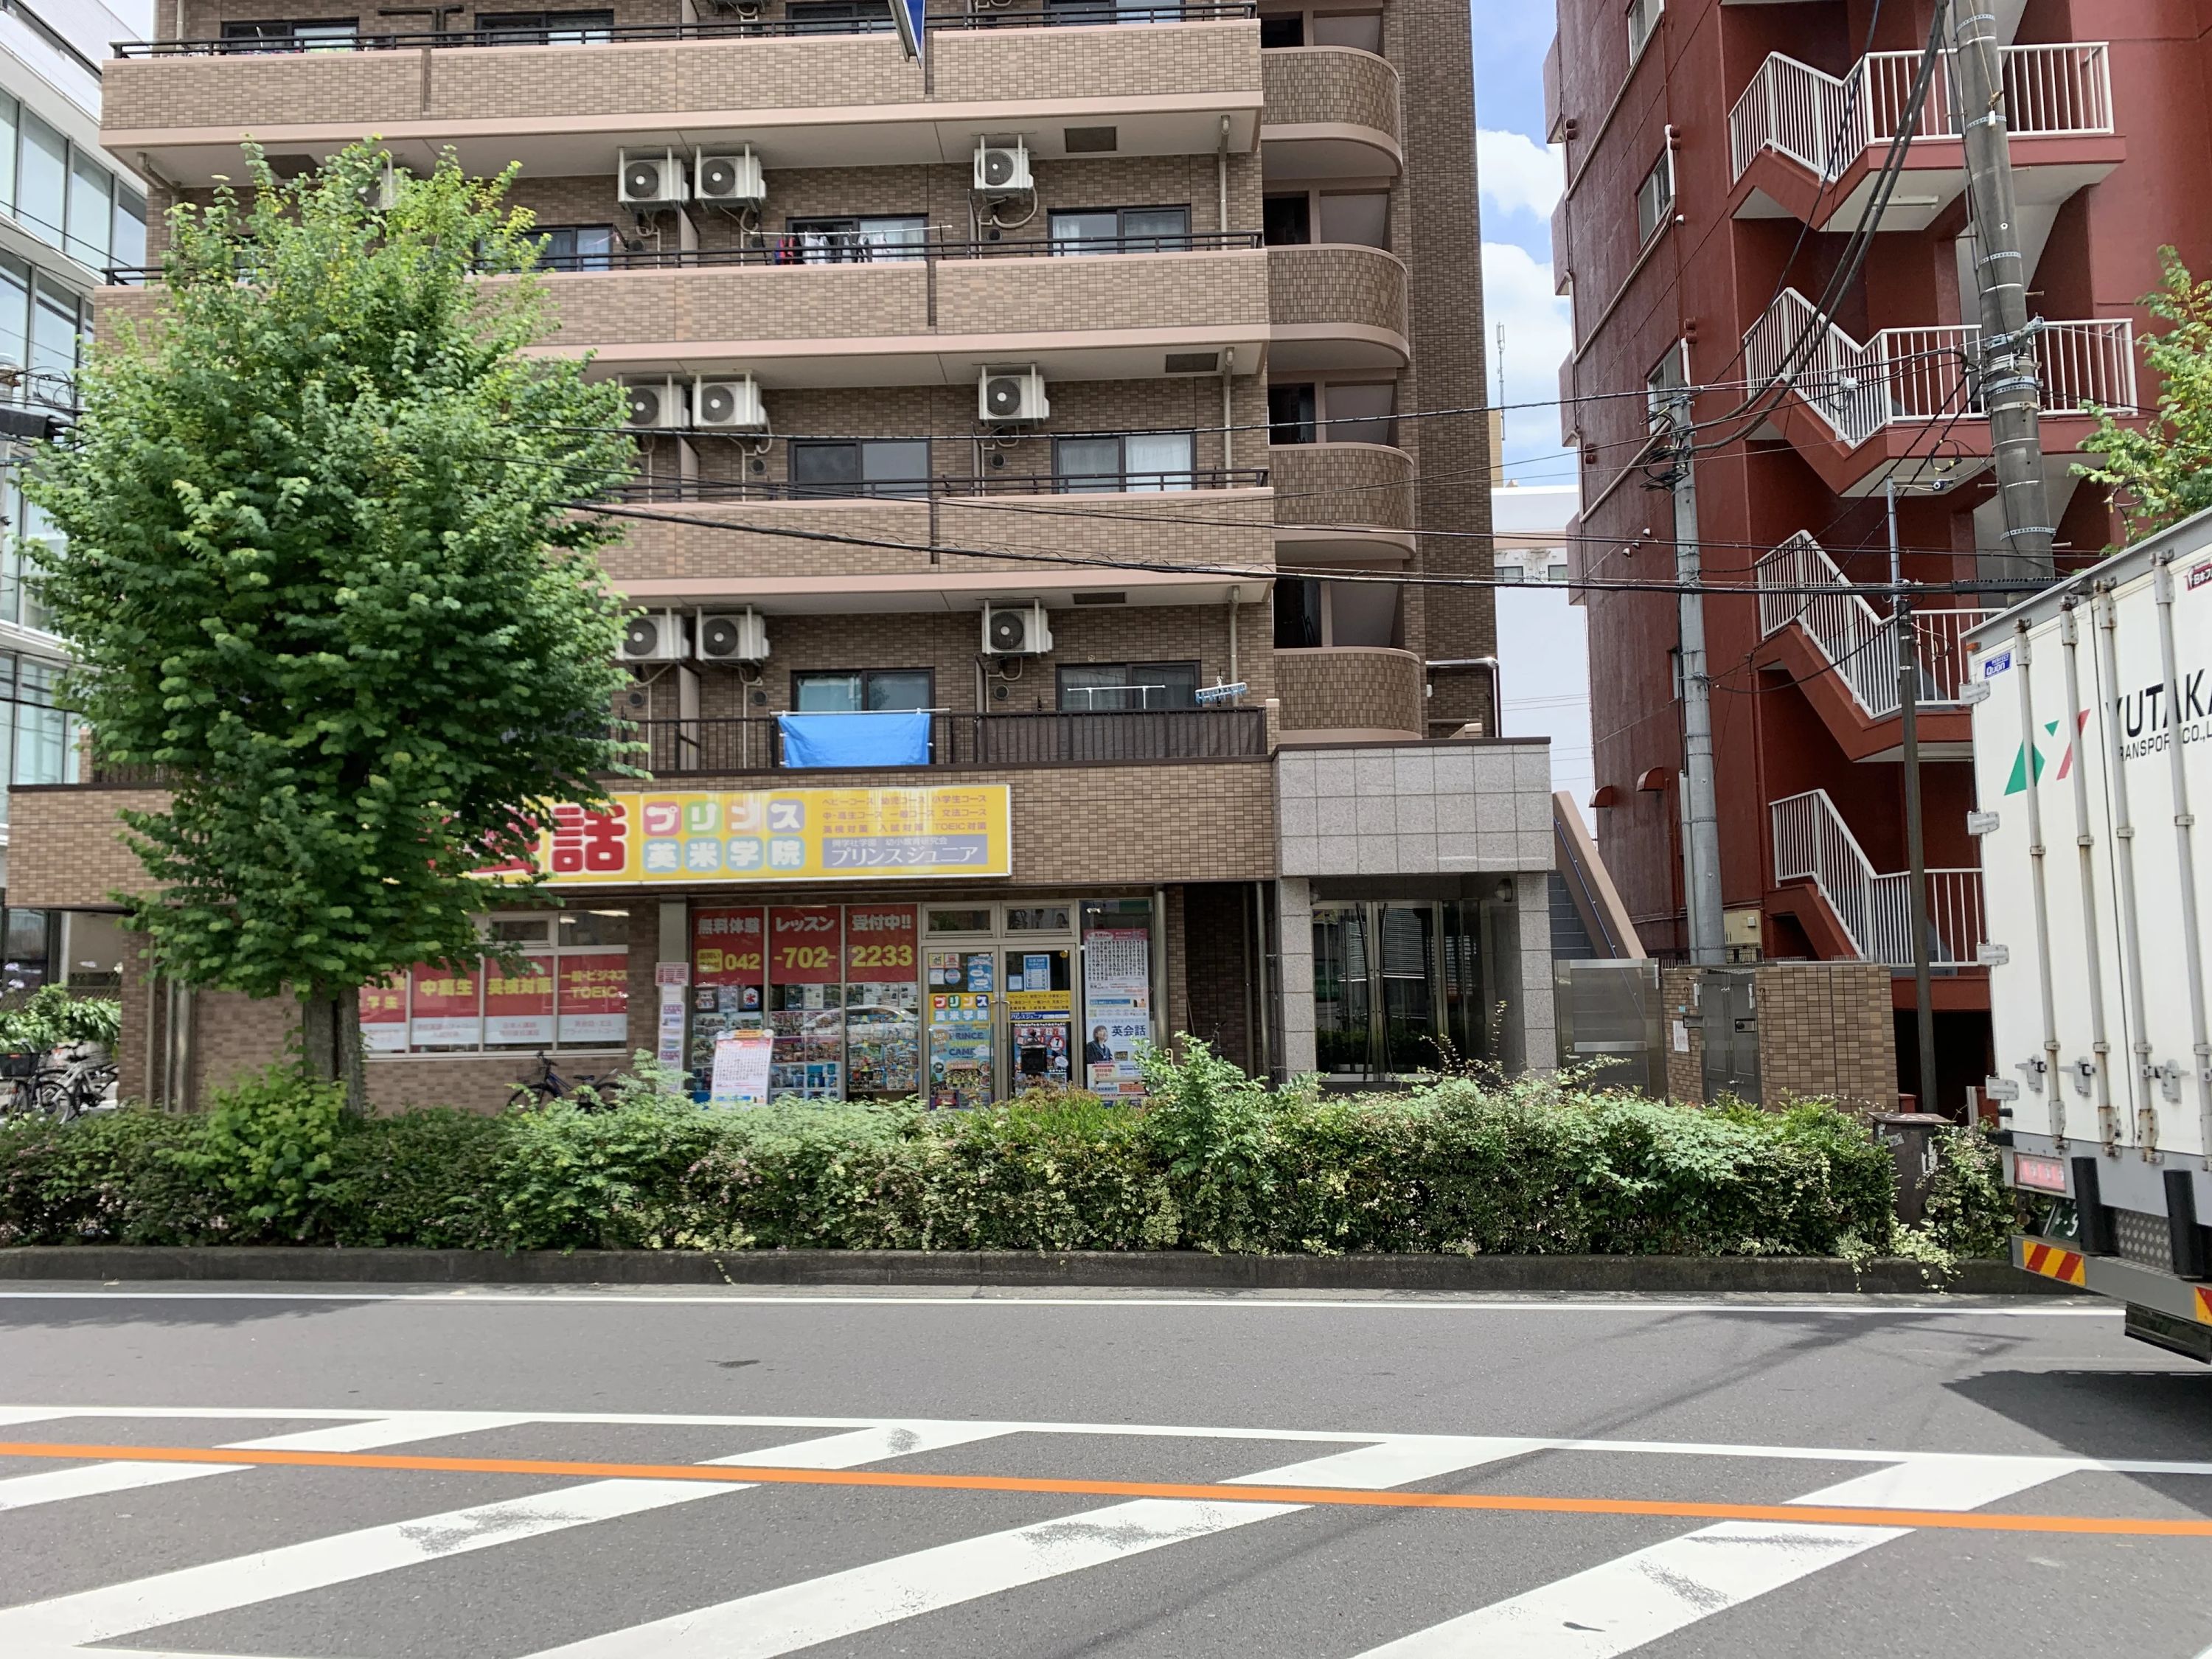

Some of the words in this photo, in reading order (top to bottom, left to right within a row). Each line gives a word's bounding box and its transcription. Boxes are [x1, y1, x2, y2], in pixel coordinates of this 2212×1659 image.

[1986, 662, 2006, 675] Quon
[881, 796, 925, 805] 幼児コース
[932, 794, 987, 803] 小学生コース
[646, 801, 801, 832] プリンス
[890, 810, 935, 819] 一般コース
[942, 808, 987, 818] 文法コース
[823, 824, 869, 834] 英検対策
[879, 823, 924, 832] 入試対策
[647, 838, 803, 869] 英米学院
[831, 846, 978, 866] プリンスジュニア
[698, 917, 760, 934] 無料体験
[776, 916, 835, 932] レッスン
[724, 953, 760, 970] 042
[851, 945, 913, 967] 2233
[487, 976, 552, 995] 英検対策
[570, 985, 618, 998] TOEIC
[933, 996, 989, 1008] プリンス
[1111, 1025, 1147, 1037] 英会話
